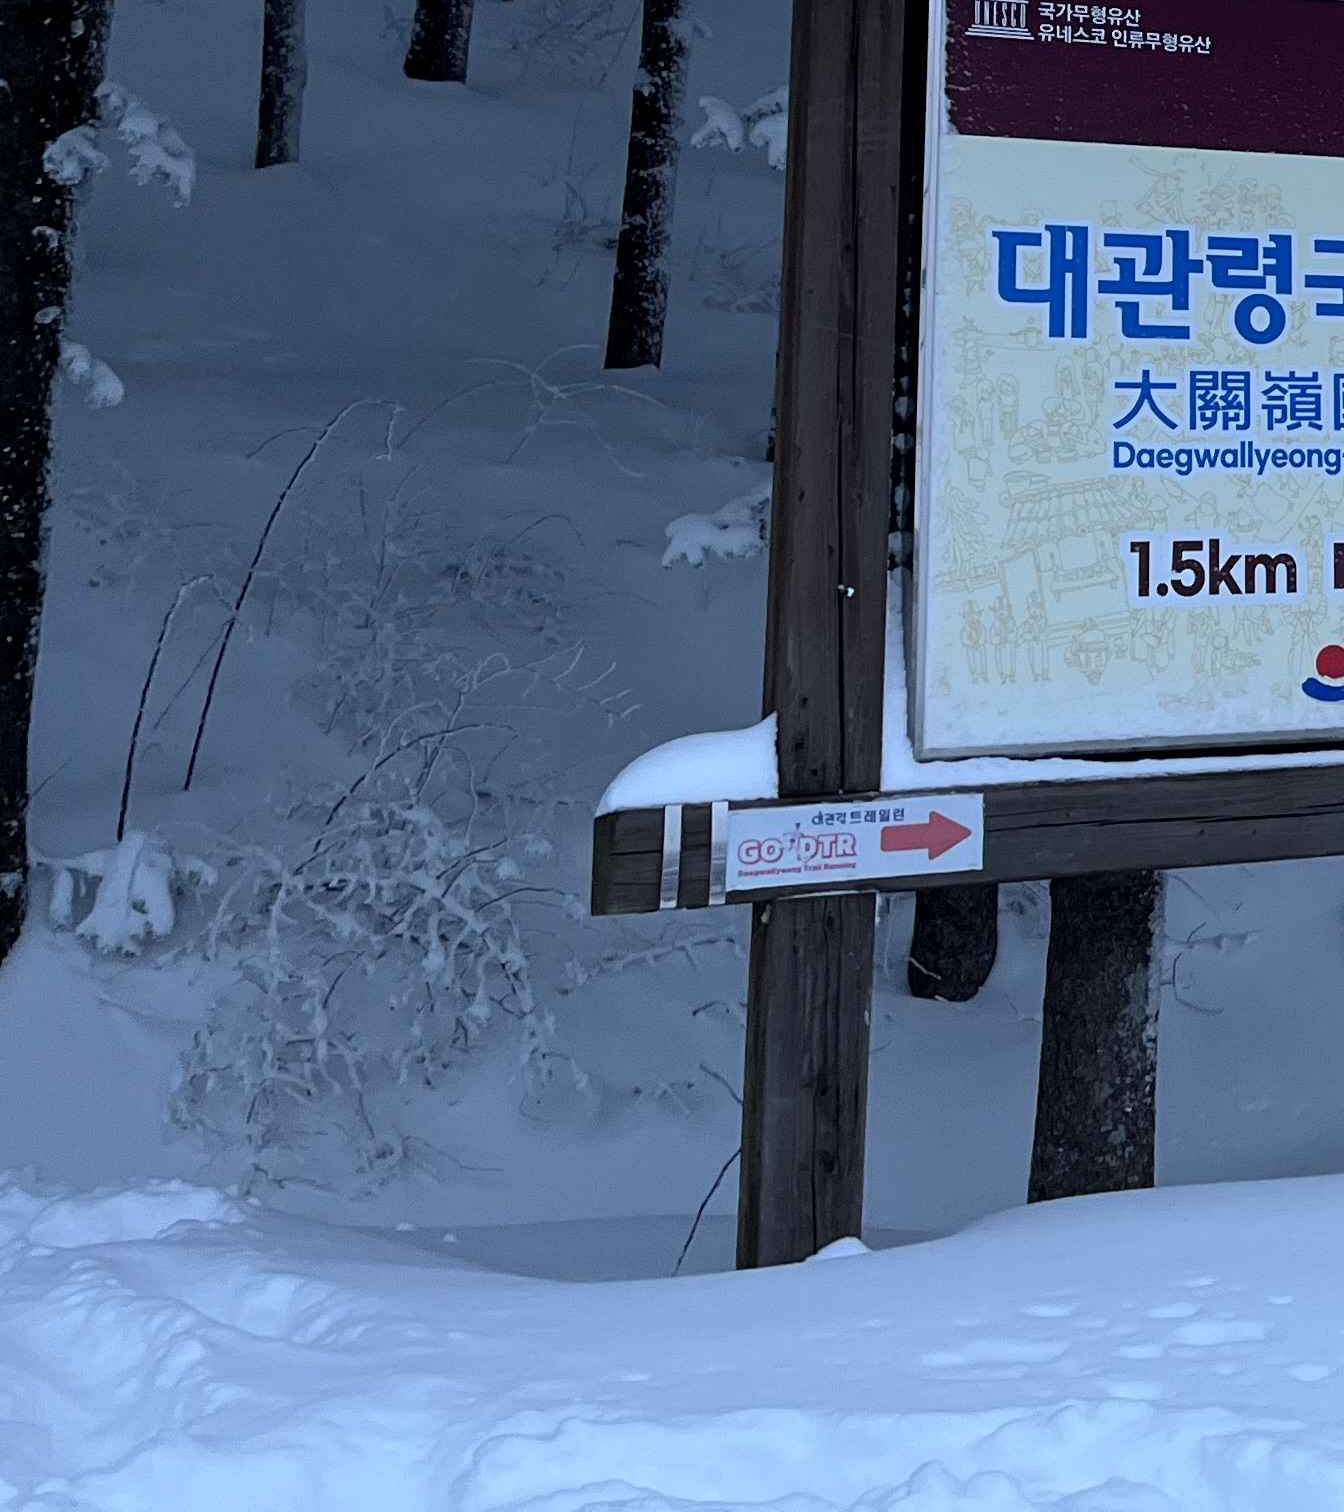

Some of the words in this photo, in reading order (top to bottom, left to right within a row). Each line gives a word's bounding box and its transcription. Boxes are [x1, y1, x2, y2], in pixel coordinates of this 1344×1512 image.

[1038, 1, 1142, 28] 국가무형유산
[1038, 23, 1108, 46] 유네스코
[1111, 27, 1212, 54] 인류무형유산
[1129, 538, 1298, 598] 1.5km
